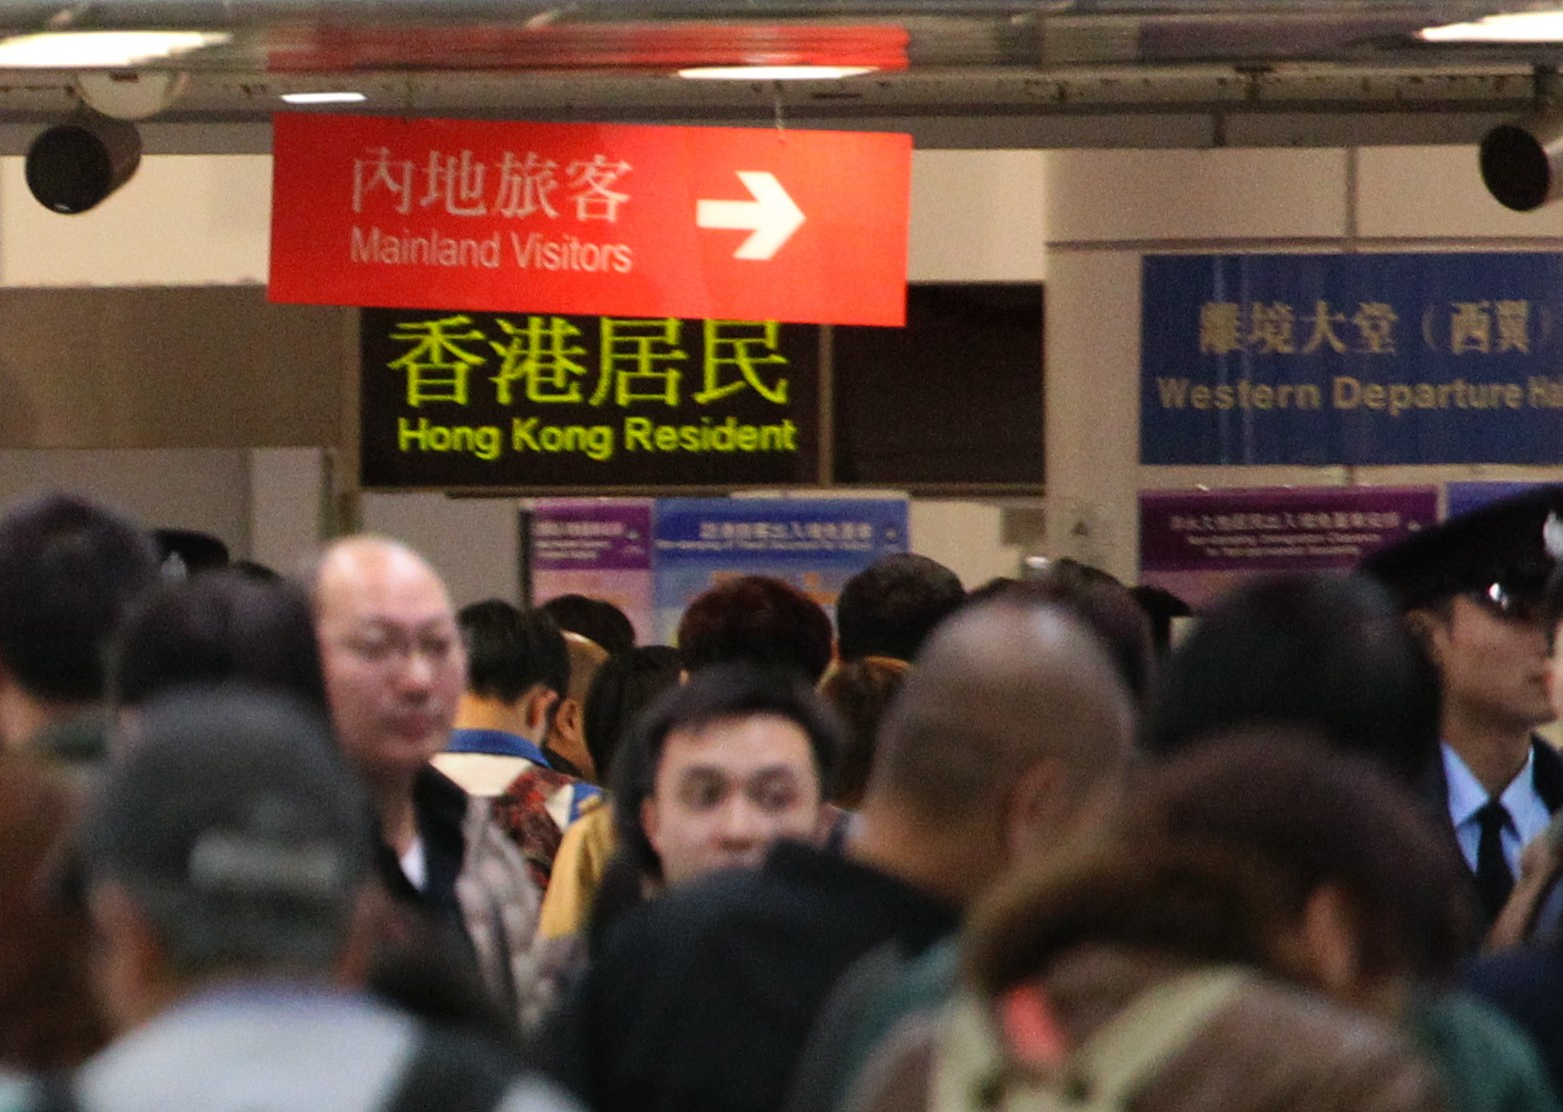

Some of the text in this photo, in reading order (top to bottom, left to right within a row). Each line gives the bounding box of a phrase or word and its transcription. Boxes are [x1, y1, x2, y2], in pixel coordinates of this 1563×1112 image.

[350, 225, 633, 273] Mainland Visitors
[388, 315, 788, 407] 香港居民
[1157, 377, 1321, 411] Western
[1332, 375, 1522, 417] Departure
[399, 418, 797, 460] Hong Kong Resident
